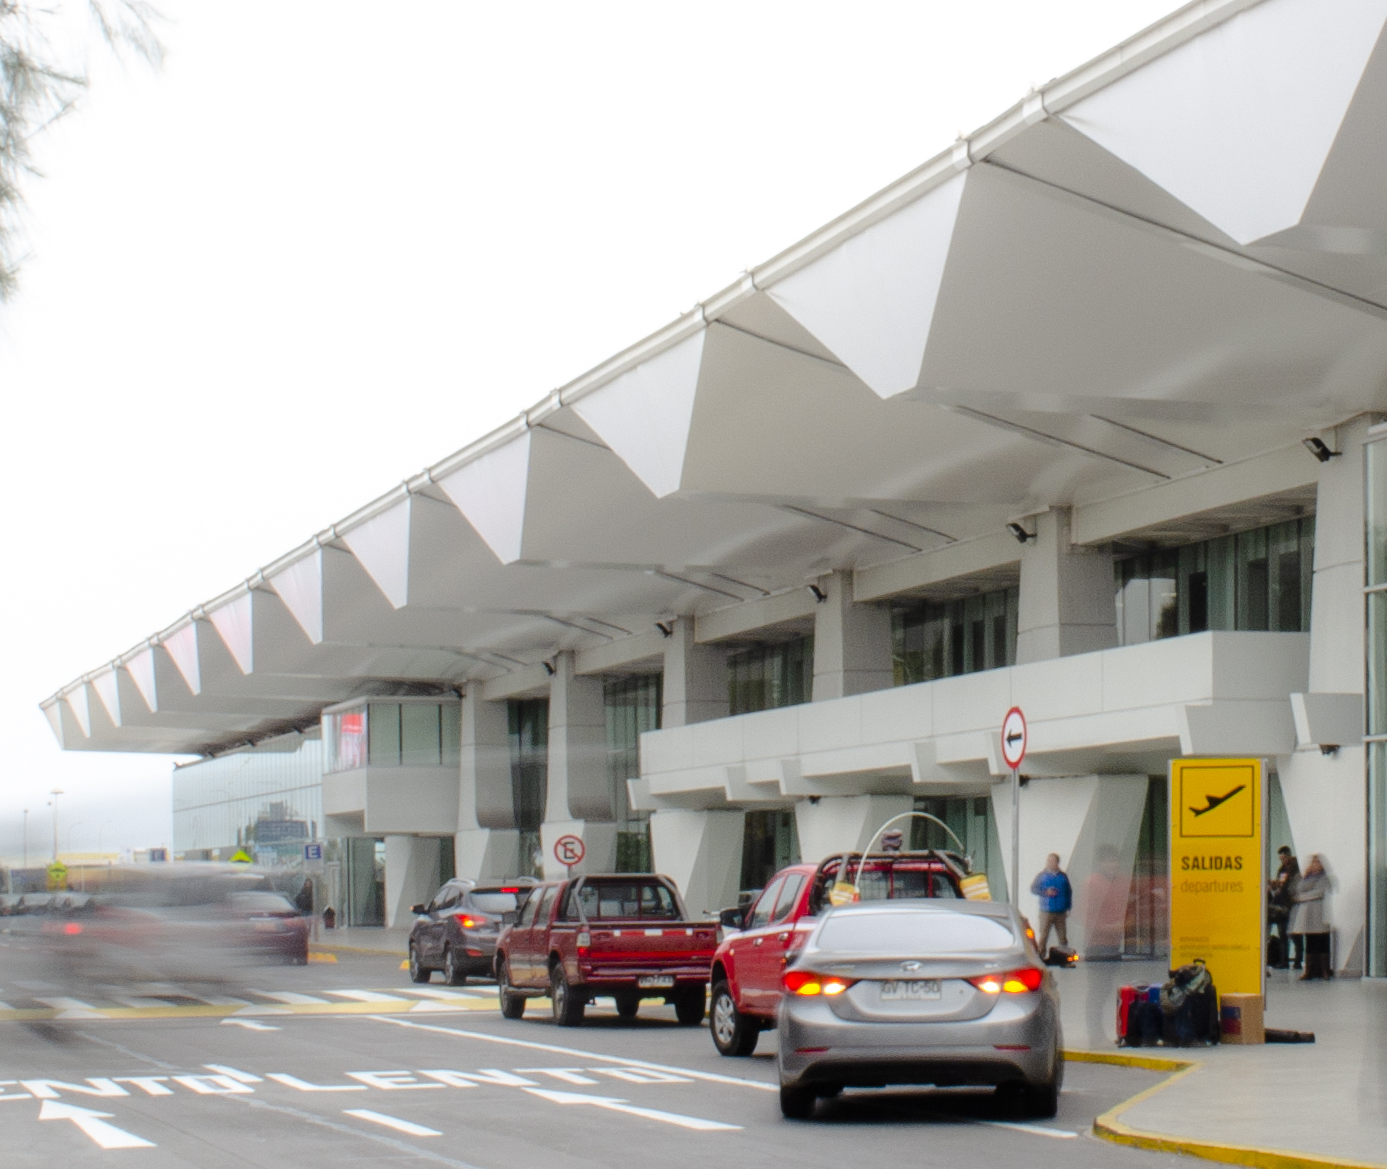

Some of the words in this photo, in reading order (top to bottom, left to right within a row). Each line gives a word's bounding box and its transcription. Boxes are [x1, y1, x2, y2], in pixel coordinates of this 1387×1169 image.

[1181, 856, 1243, 870] SALIDAS
[1180, 879, 1244, 896] departures
[266, 1068, 695, 1091] LENTO
